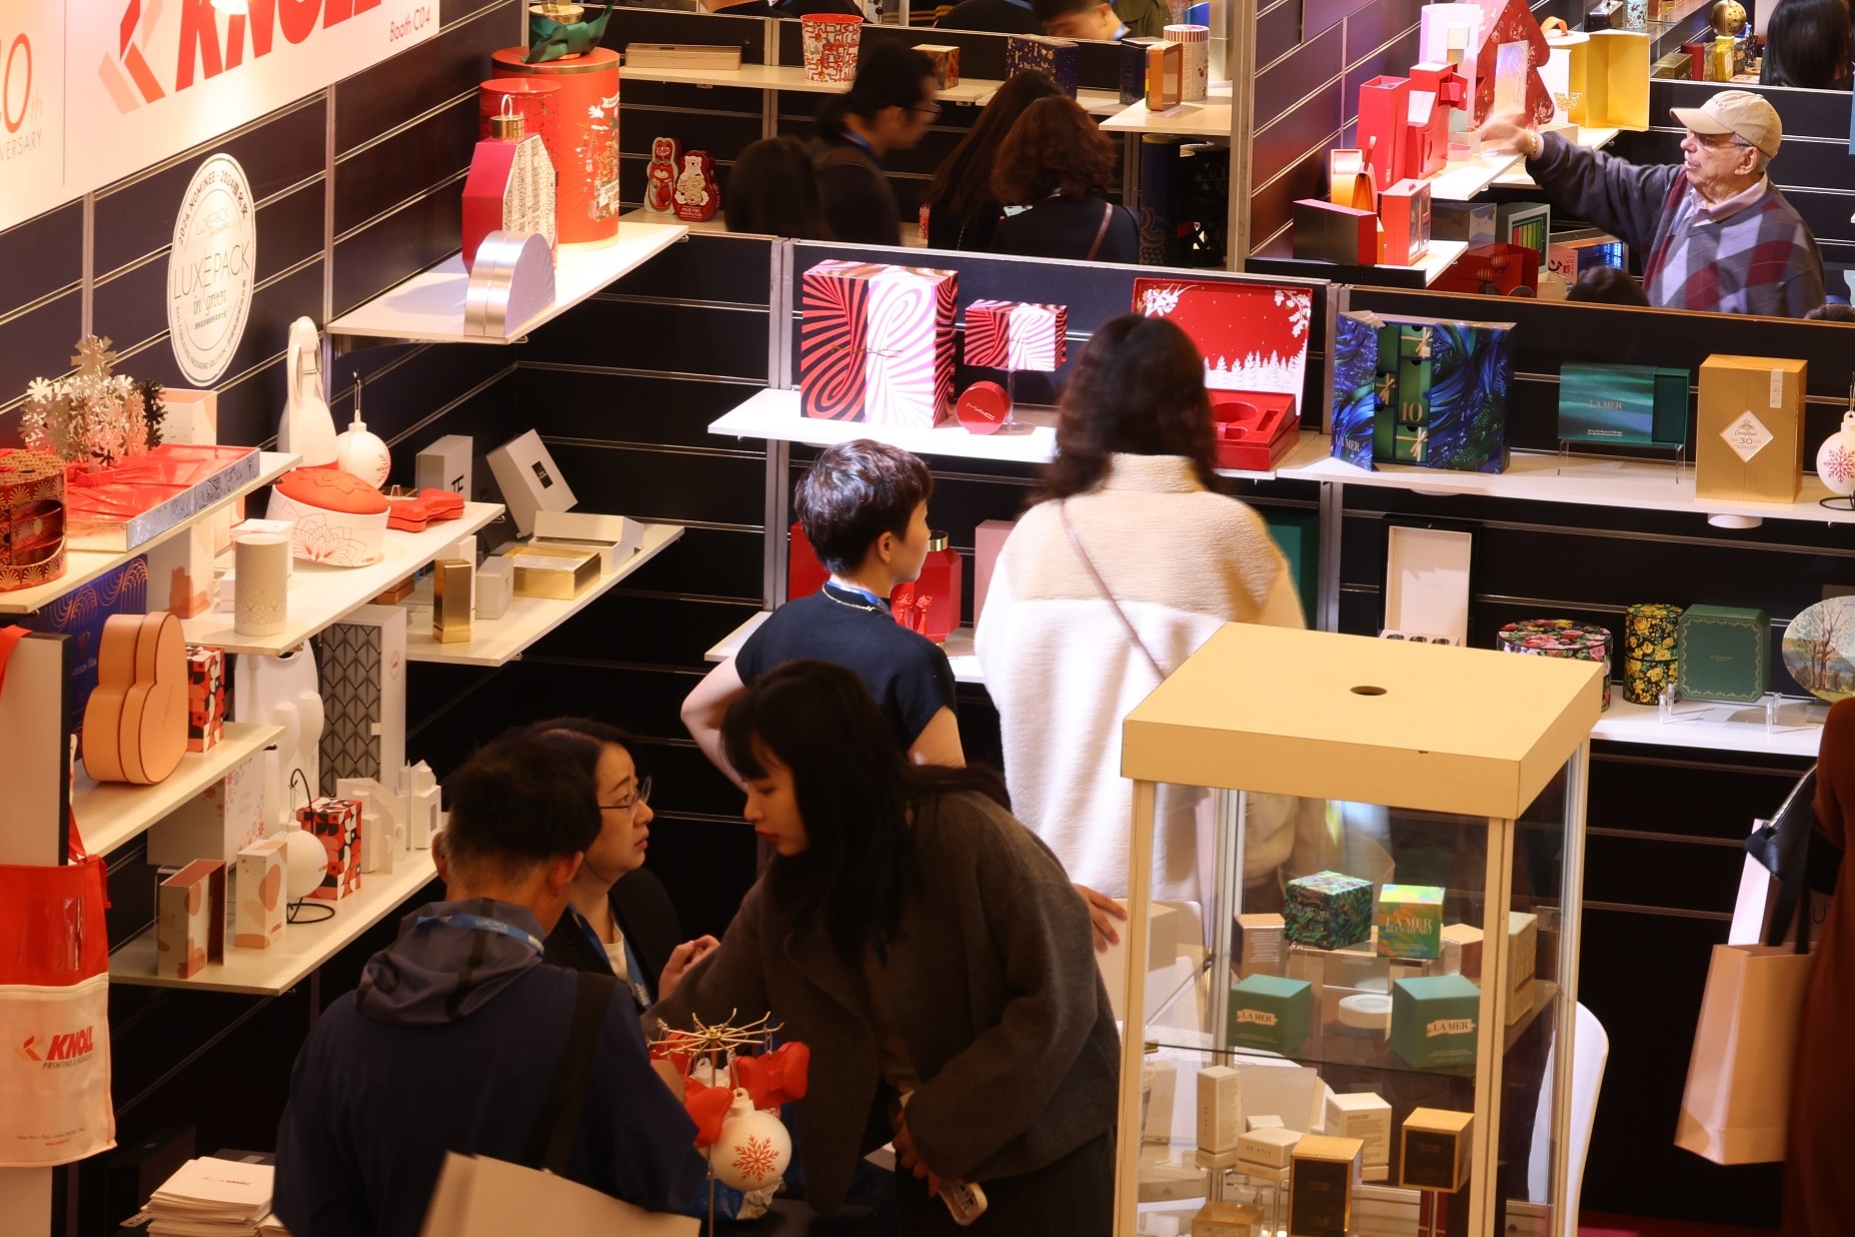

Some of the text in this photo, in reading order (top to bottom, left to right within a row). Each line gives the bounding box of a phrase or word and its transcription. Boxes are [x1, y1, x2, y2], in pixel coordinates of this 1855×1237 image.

[390, 5, 431, 43] Booth C04
[190, 170, 217, 210] NOMINEE
[173, 240, 250, 301] LUXEPACK
[1402, 401, 1424, 422] 10
[1604, 401, 1623, 410] MER
[1739, 437, 1753, 445] 30
[1386, 916, 1433, 929] LA MER
[1242, 1010, 1273, 1023] LA MER
[1433, 1022, 1469, 1033] LA MER
[46, 1025, 94, 1061] KNOLL
